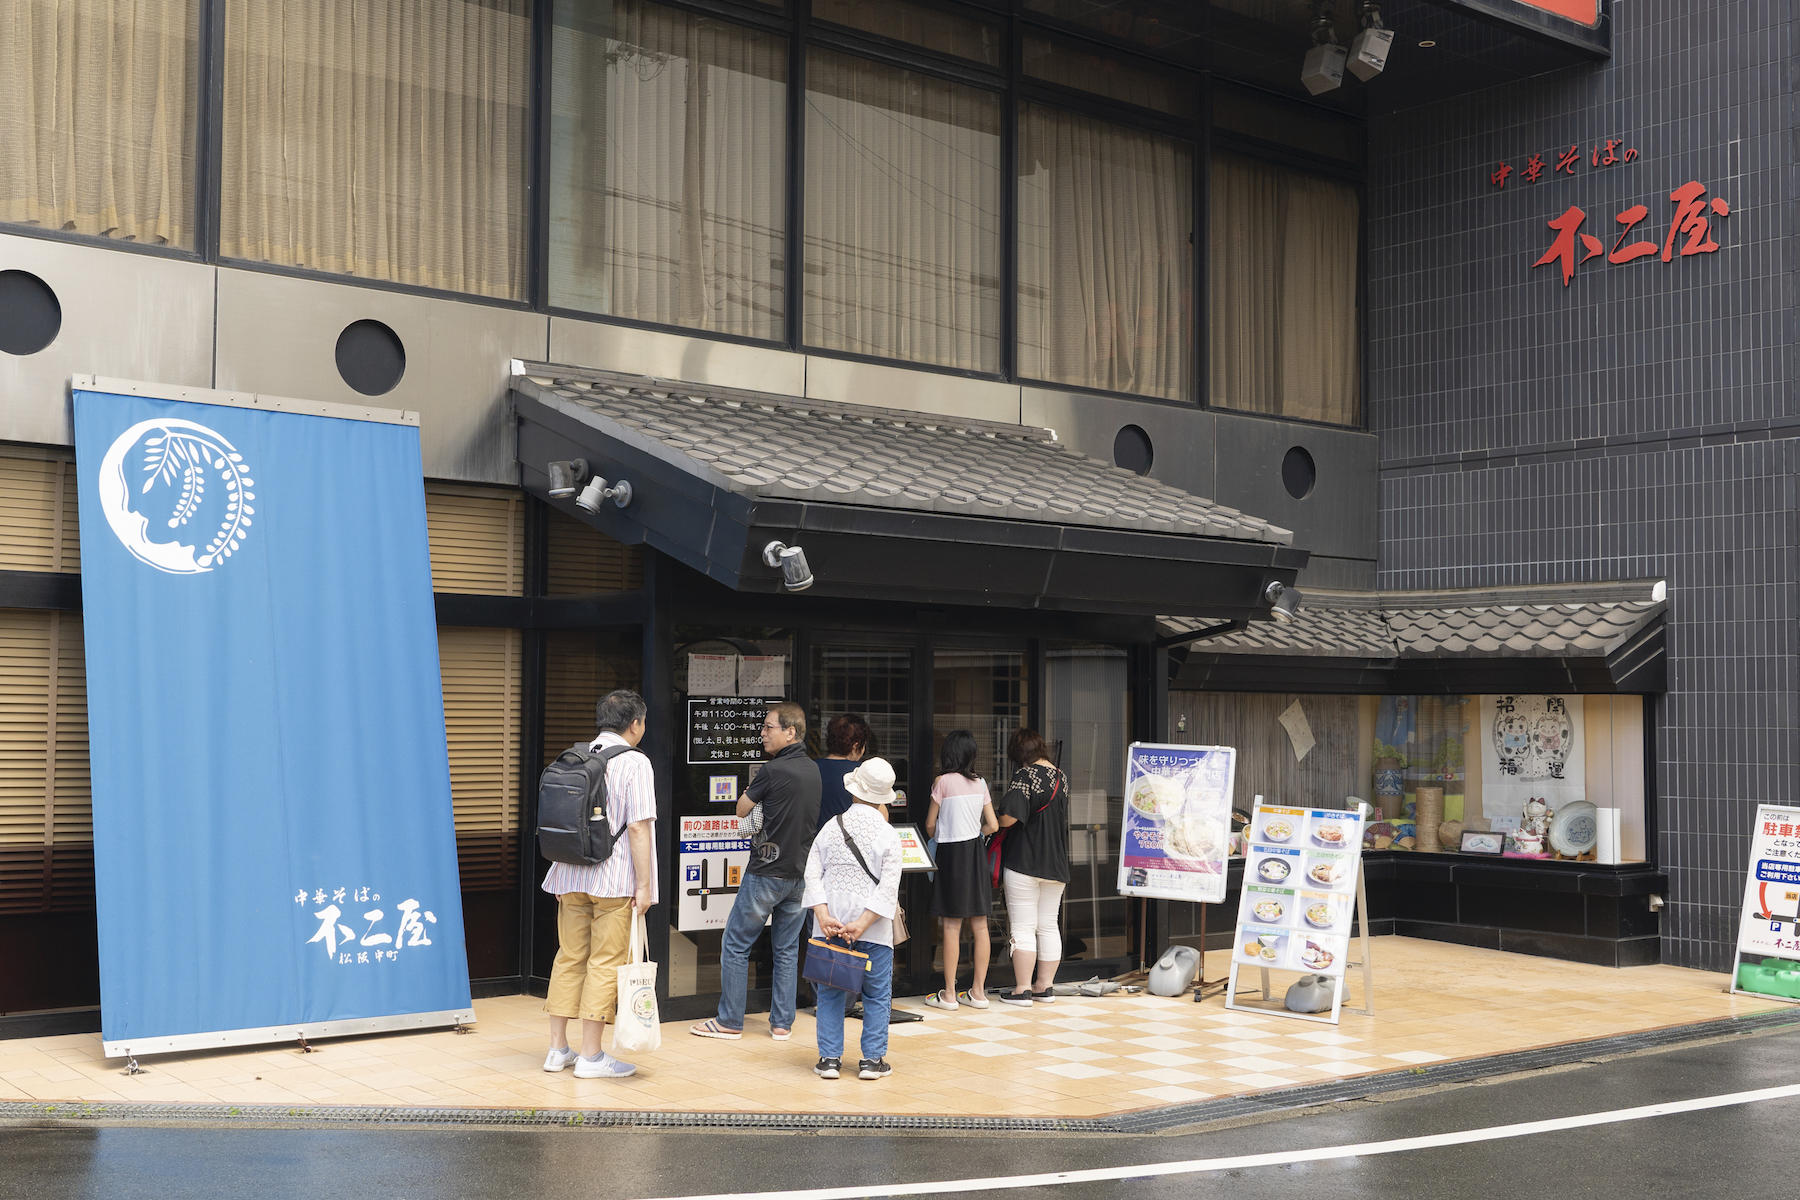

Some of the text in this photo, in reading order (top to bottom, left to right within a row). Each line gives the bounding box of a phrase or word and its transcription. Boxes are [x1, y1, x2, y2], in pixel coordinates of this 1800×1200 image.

[1491, 139, 1638, 188] 中華そばの
[1531, 180, 1730, 287] 不二屋
[1763, 813, 1790, 822] この前は
[294, 886, 381, 907] 中華そばの
[305, 898, 437, 960] 不二屋
[1772, 922, 1780, 931] P
[339, 949, 399, 965] 松阪中町
